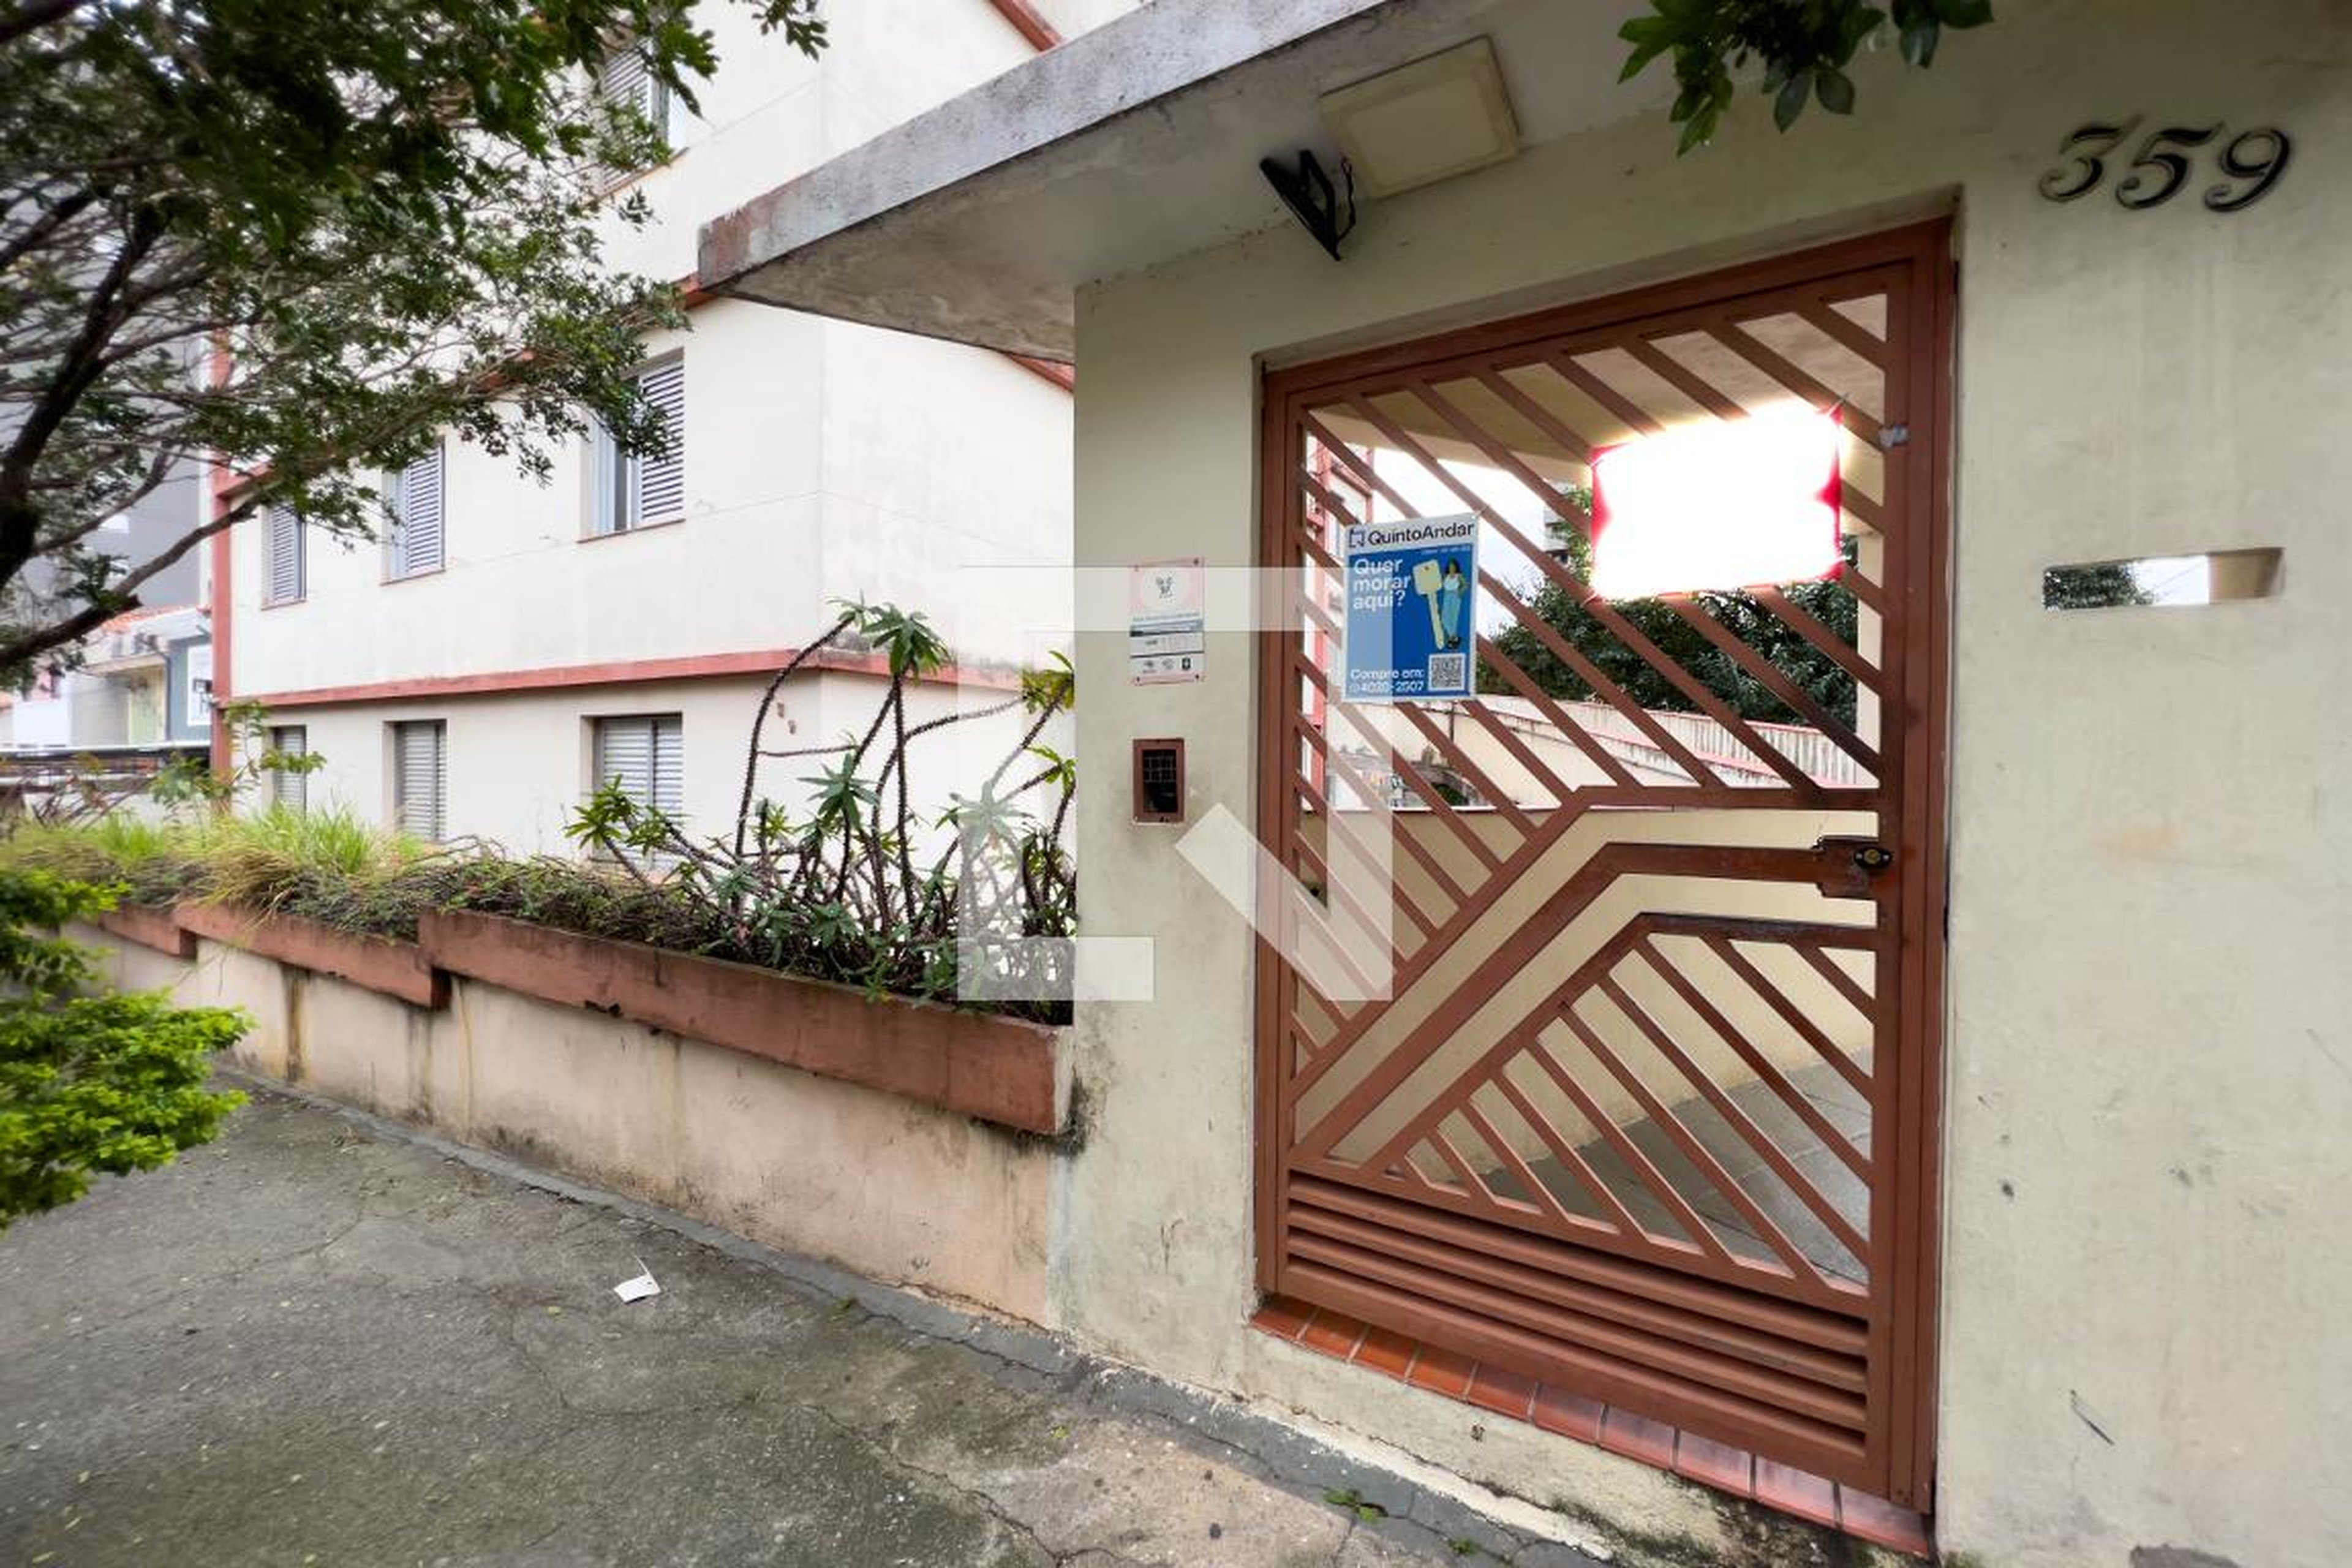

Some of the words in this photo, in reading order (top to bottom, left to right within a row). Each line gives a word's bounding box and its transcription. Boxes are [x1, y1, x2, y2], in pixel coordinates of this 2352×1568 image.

[2038, 116, 2290, 212] 359
[1368, 522, 1474, 546] QuintoAndar
[1354, 558, 1403, 575] Quer
[1353, 575, 1411, 592] morar
[1353, 590, 1406, 612] aqui?
